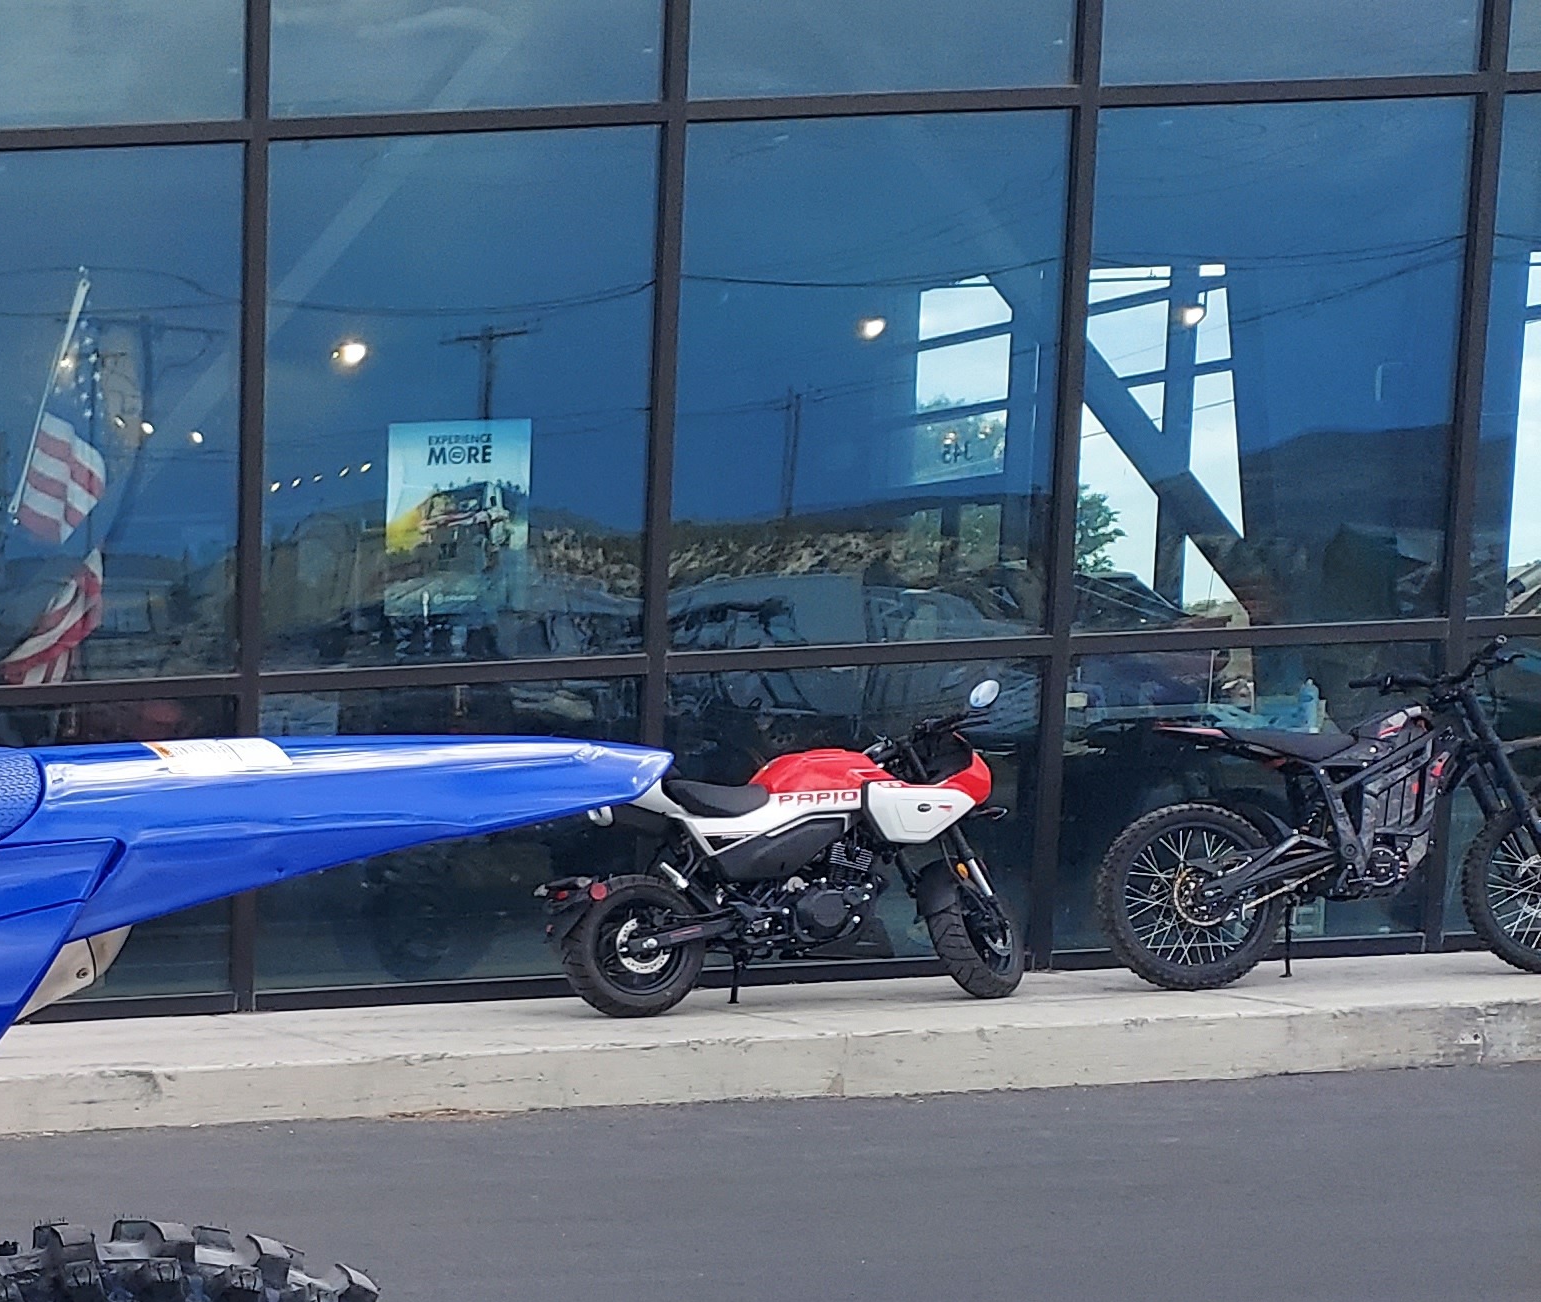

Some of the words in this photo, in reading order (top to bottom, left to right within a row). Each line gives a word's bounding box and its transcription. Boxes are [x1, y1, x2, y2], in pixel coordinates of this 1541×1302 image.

[428, 433, 493, 446] EXPERIENCE
[427, 445, 493, 466] MORE
[778, 791, 858, 807] PAPIO
